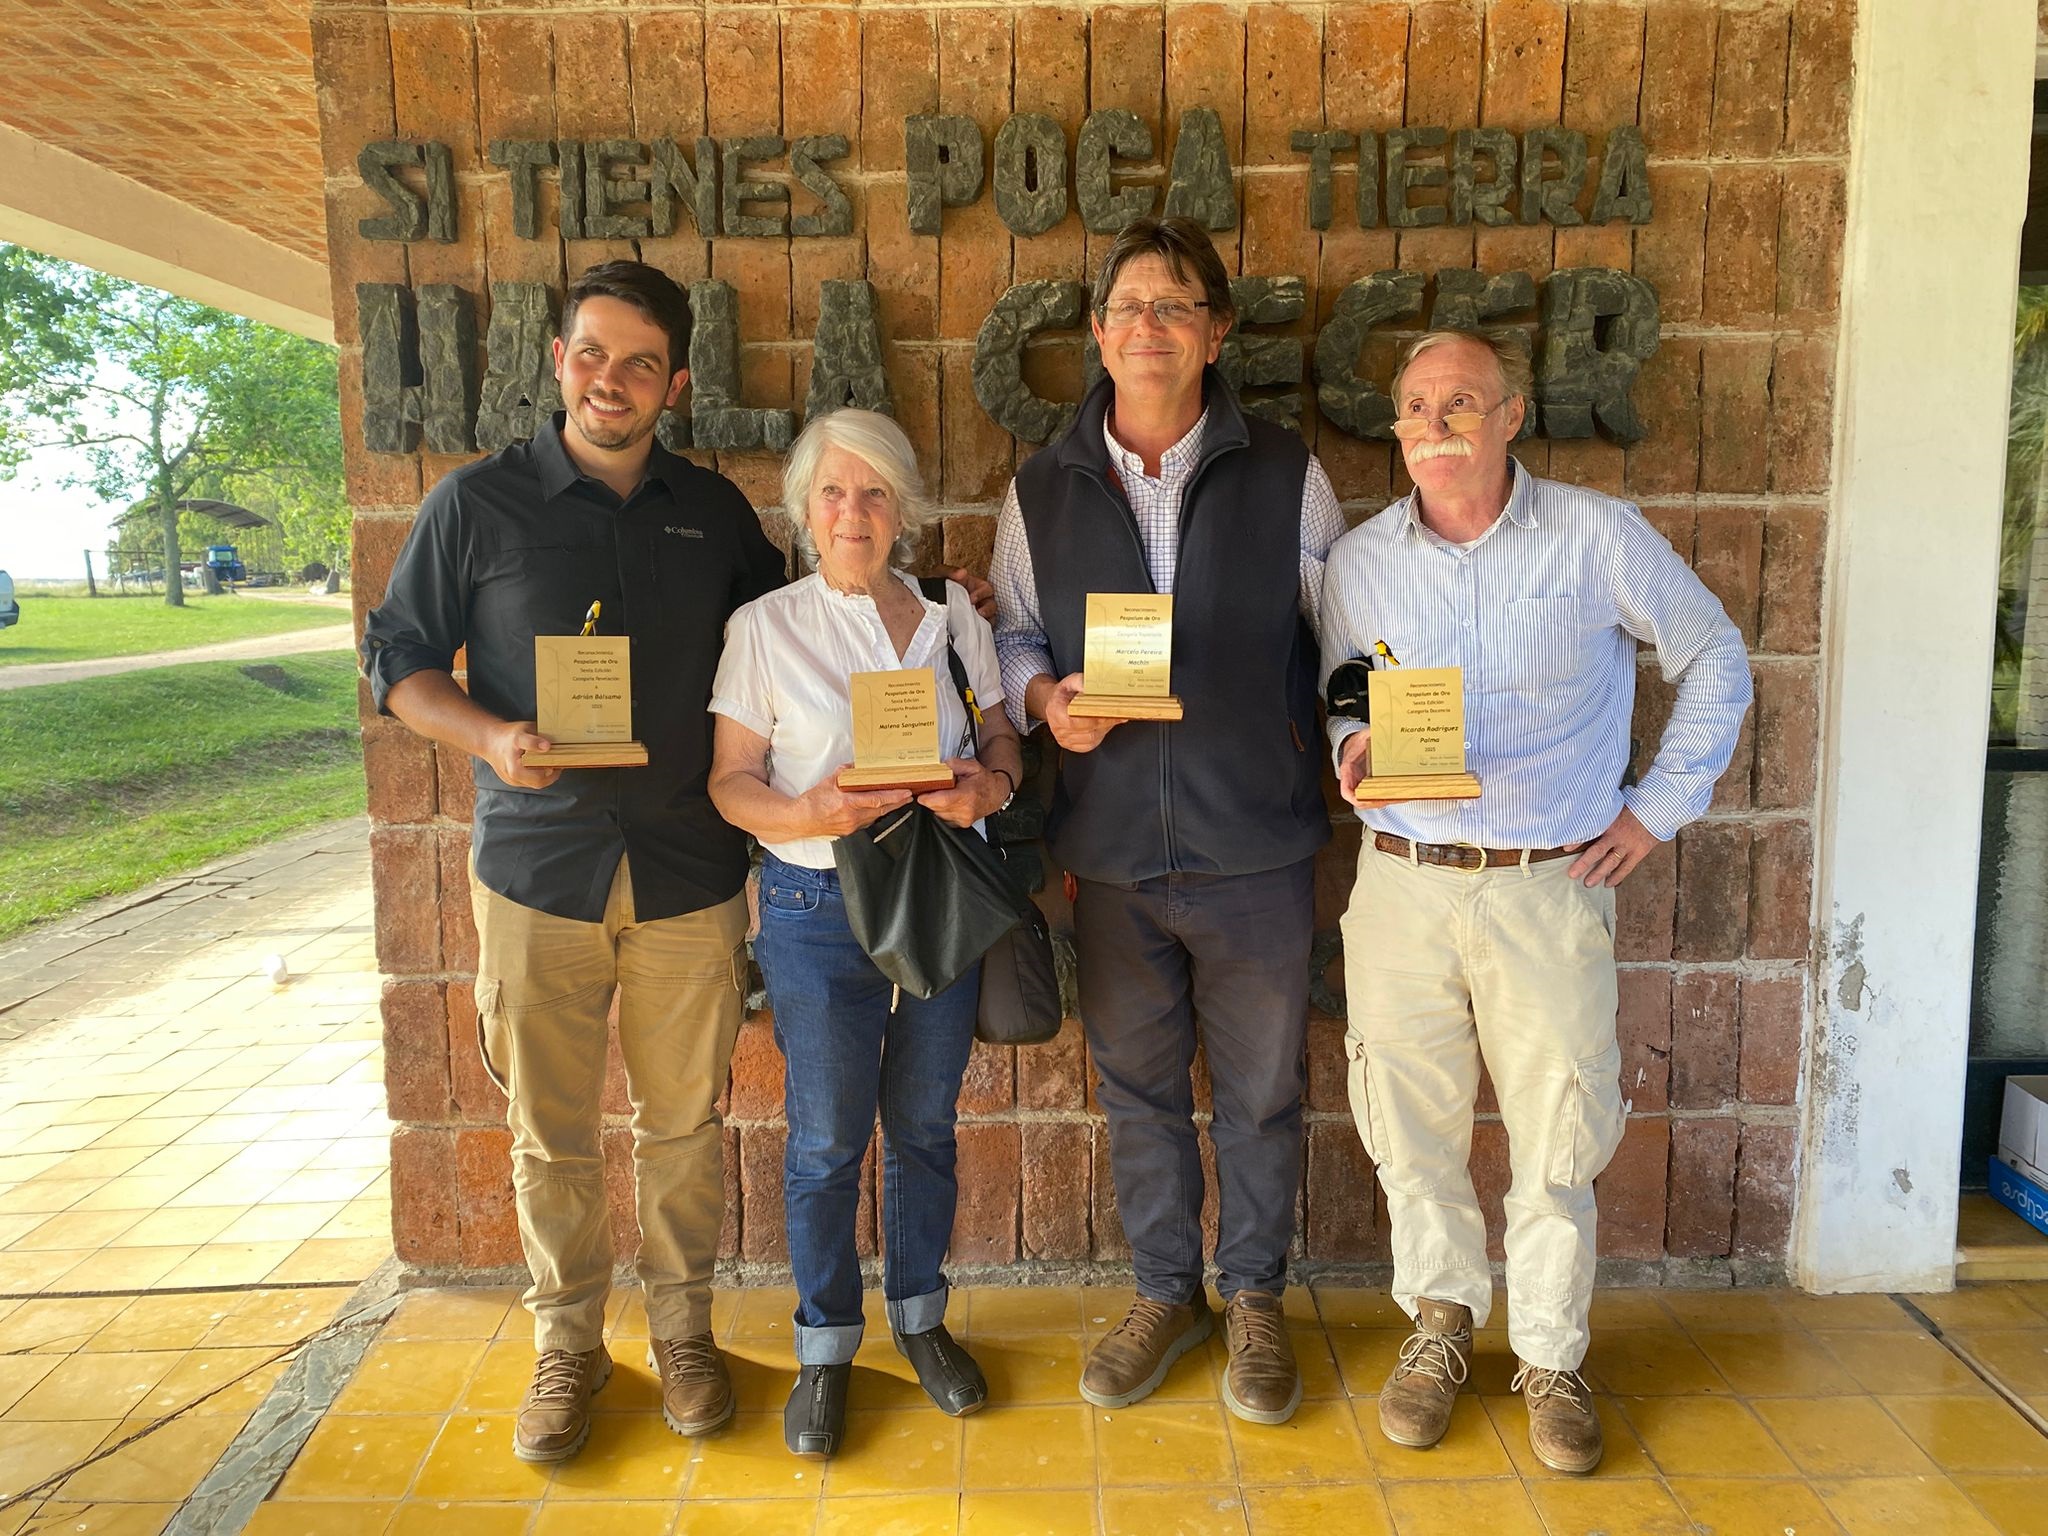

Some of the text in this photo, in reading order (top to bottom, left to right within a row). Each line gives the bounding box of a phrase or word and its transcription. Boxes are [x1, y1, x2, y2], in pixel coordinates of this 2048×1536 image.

[357, 107, 1655, 244] SI TIENES POCA TIERRA
[355, 267, 1661, 455] HALA CECER
[901, 720, 935, 729] Sanguinetti
